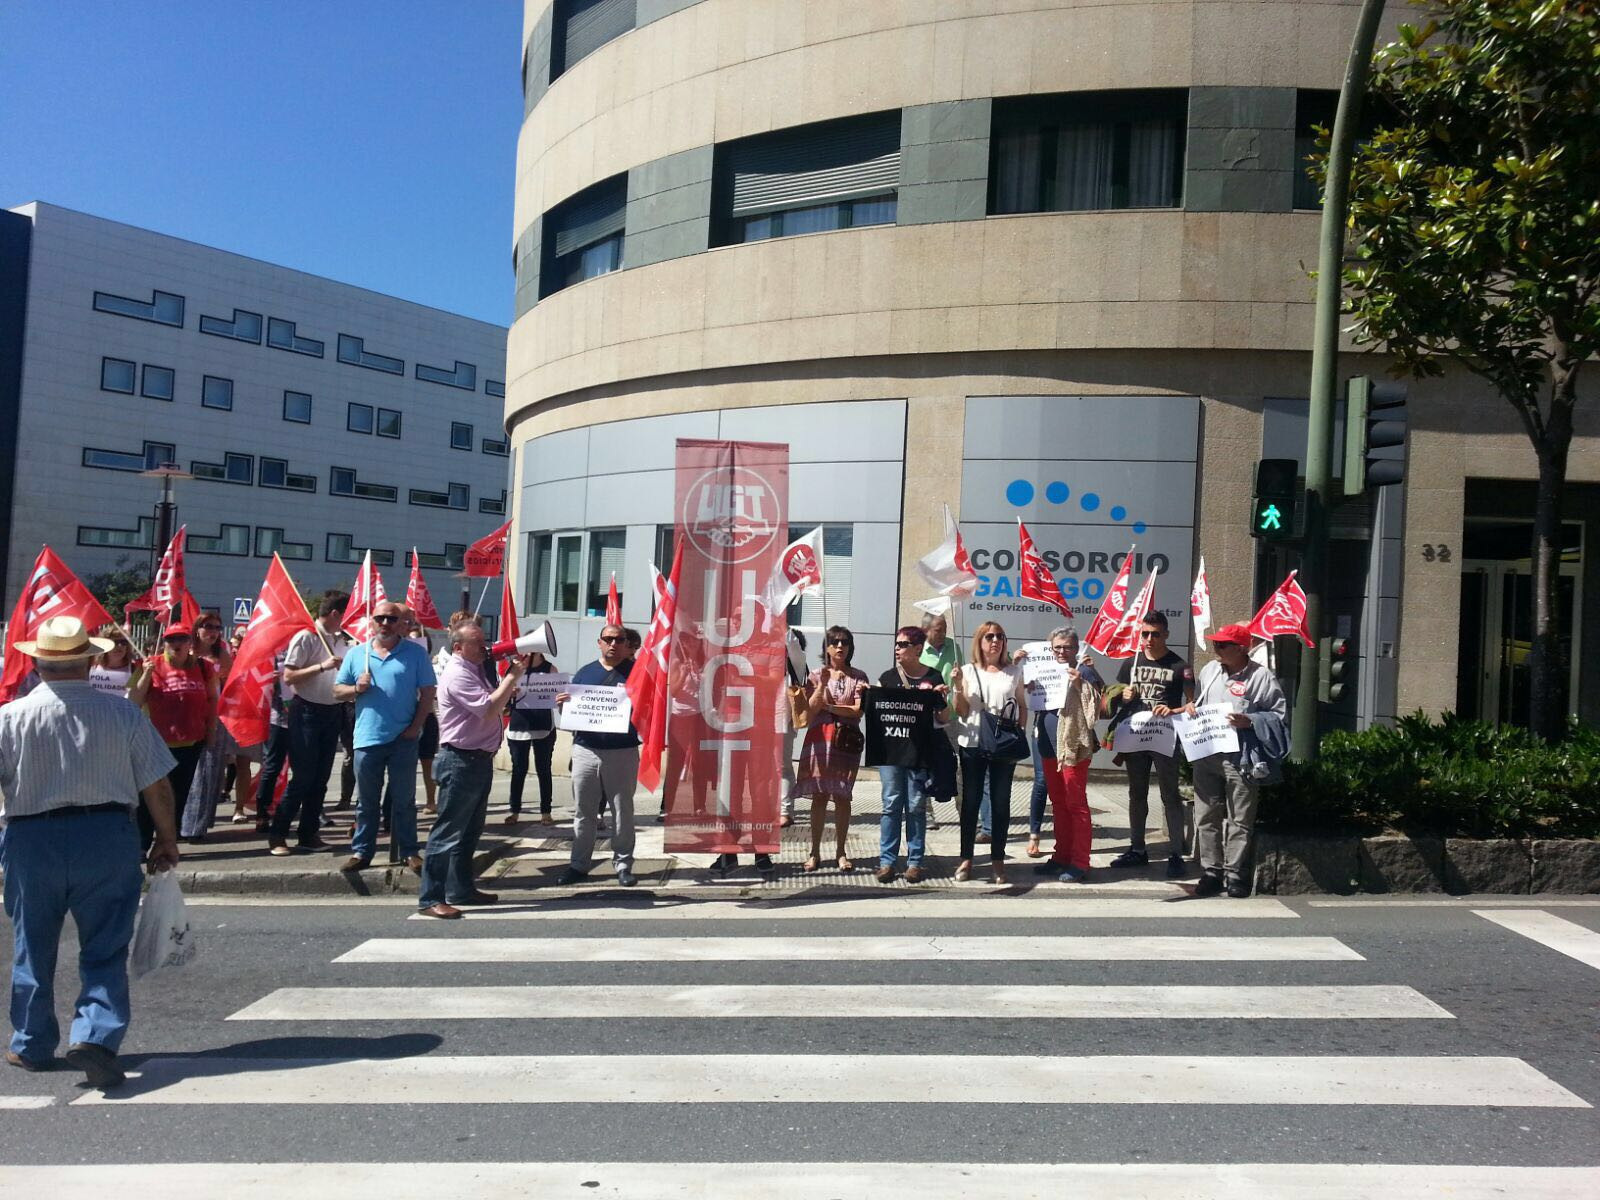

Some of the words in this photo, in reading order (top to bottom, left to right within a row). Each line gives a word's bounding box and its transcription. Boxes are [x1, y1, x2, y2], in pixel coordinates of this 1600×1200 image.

[970, 549, 1170, 576] COSORCIO
[975, 575, 1105, 600] GAGO
[969, 602, 984, 612] de
[986, 603, 1034, 613] Servizos
[1038, 604, 1053, 613] de
[581, 695, 618, 704] CONVENIO
[577, 704, 618, 712] COLECTIVO
[880, 713, 917, 723] CONVENIO
[884, 726, 910, 738] XA!!
